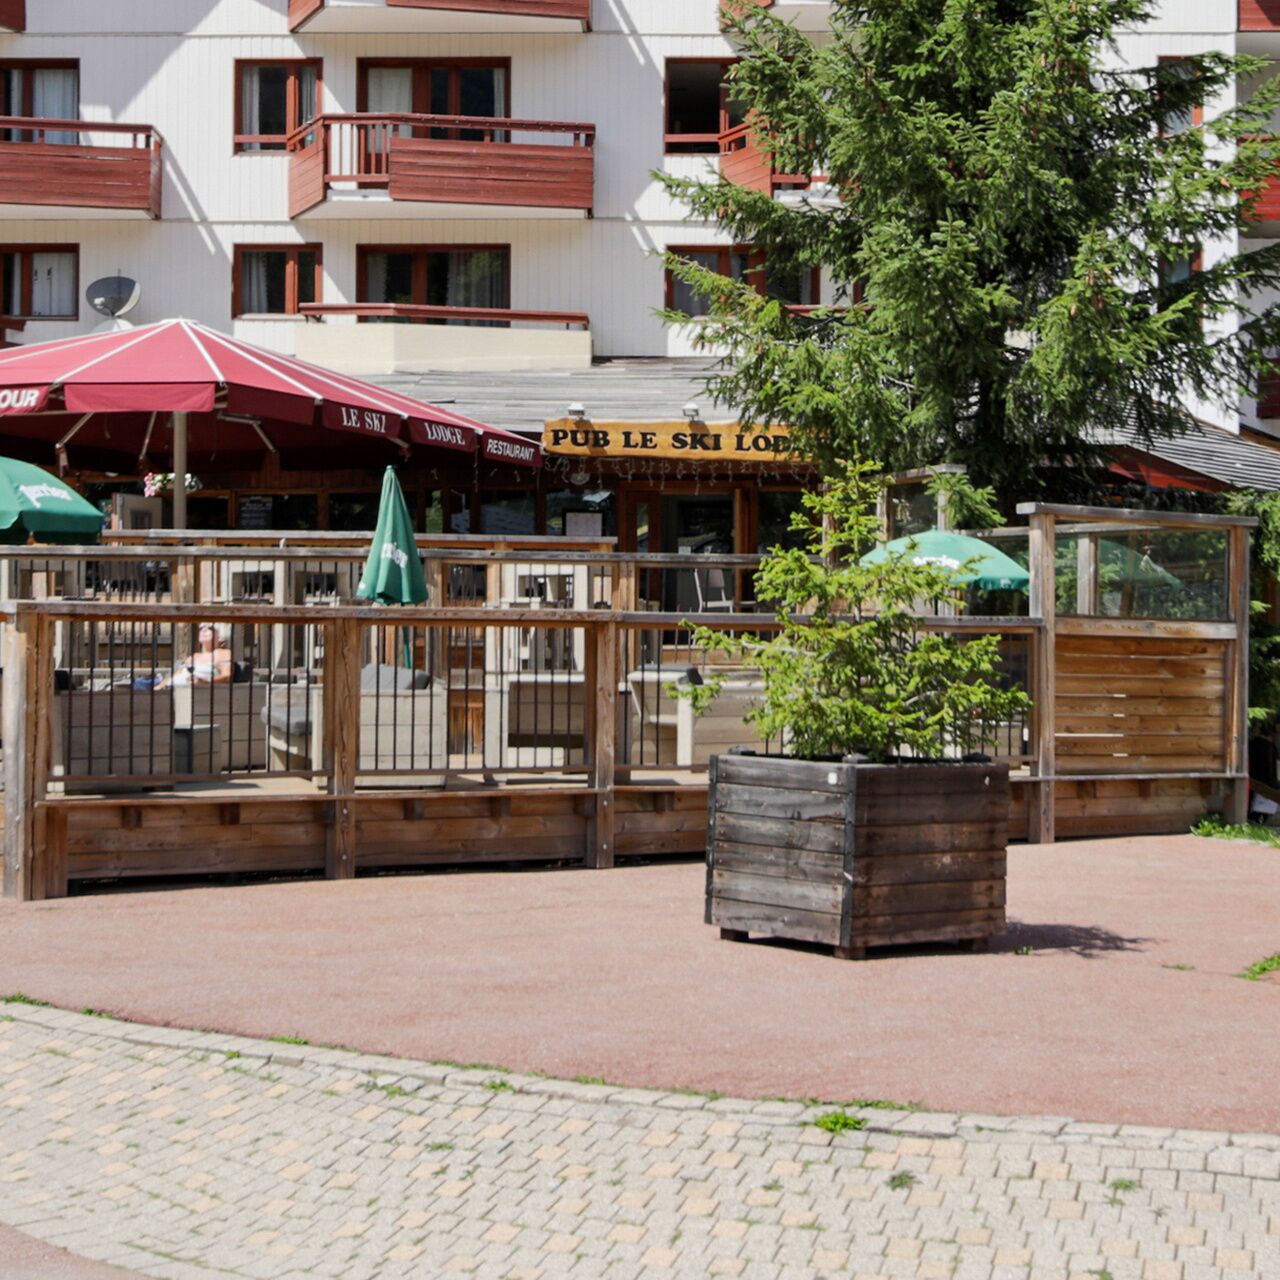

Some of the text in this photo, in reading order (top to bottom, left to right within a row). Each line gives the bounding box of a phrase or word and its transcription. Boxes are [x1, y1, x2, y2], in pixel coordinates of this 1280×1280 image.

[340, 406, 388, 433] LE SKI
[423, 422, 466, 446] LODGE
[551, 428, 791, 453] PUB LE SKI LOD
[486, 438, 535, 461] RESTAURANT
